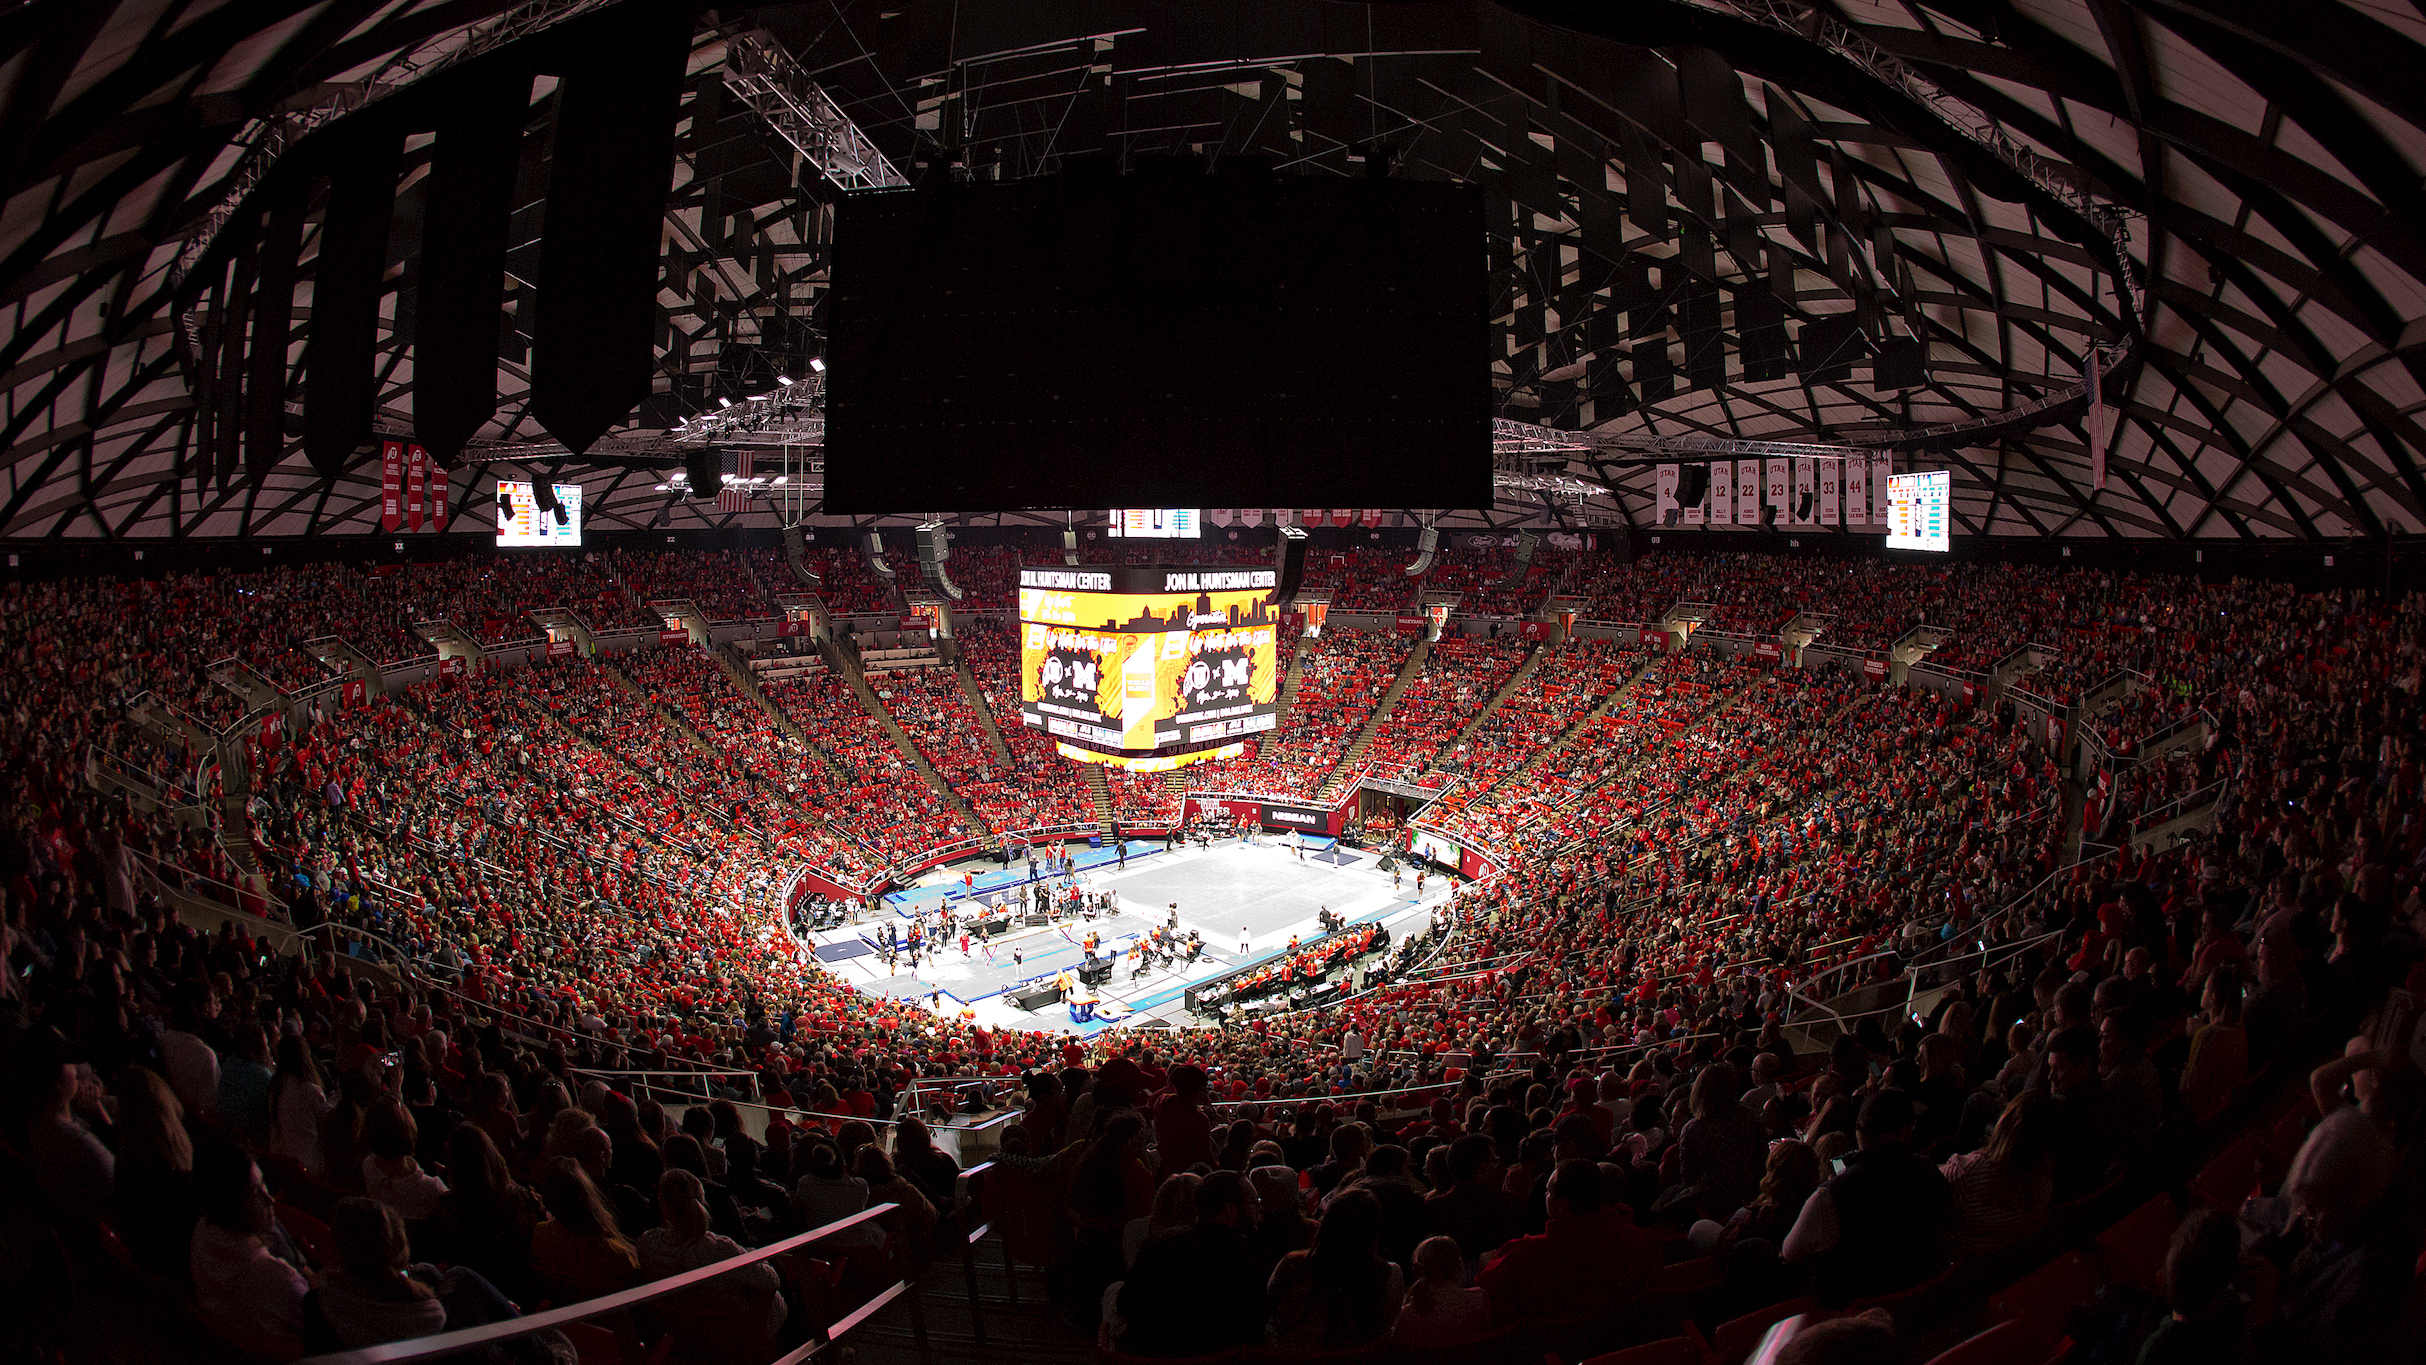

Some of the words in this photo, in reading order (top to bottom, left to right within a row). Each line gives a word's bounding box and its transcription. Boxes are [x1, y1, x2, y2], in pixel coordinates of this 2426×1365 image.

[1713, 467, 1728, 475] UTAH
[1741, 466, 1756, 475] UTAH
[1770, 464, 1785, 474] UTAH
[1822, 461, 1835, 470] UTAH
[1660, 469, 1675, 478] UTAH
[1715, 486, 1726, 497] 12
[1742, 485, 1754, 496] 22
[1771, 484, 1783, 496] 23
[1799, 483, 1809, 495] 24
[1823, 481, 1834, 494] 33
[1849, 480, 1860, 493] 44
[1664, 487, 1670, 498] 4
[1472, 536, 1496, 547] Ford
[1038, 571, 1077, 589] HUNTSMAN
[1077, 572, 1112, 590] CENTER
[1165, 573, 1186, 591] JON
[1187, 573, 1200, 590] M.
[1200, 571, 1250, 590] HUNTSMAN
[1250, 570, 1276, 588] CENTER
[1072, 660, 1097, 691] M
[1222, 657, 1249, 687] M
[1271, 810, 1316, 825] NISSAN
